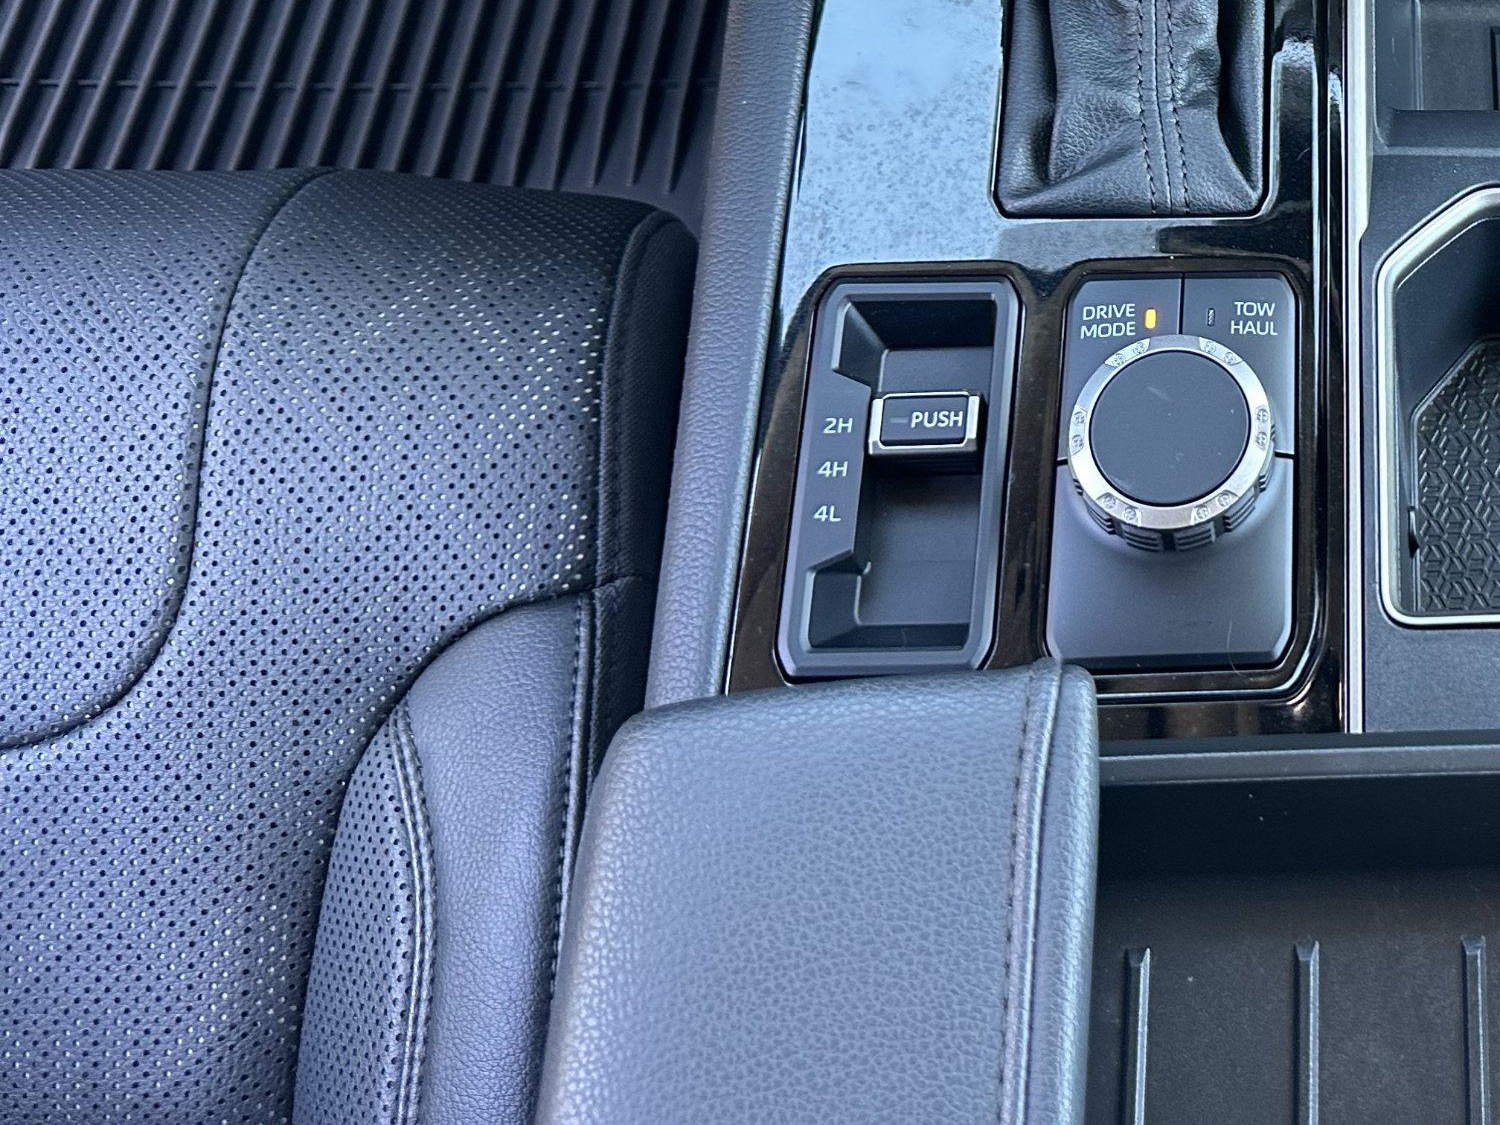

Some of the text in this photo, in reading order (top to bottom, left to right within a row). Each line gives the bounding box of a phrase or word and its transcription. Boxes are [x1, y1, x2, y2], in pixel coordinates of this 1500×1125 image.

[1082, 303, 1136, 321] DRIVE
[1234, 301, 1276, 317] TOW
[1080, 321, 1136, 339] MODE
[1230, 320, 1279, 336] HAUL
[822, 417, 854, 434] 2H
[910, 410, 964, 429] PUSH
[817, 461, 849, 478] 4H
[813, 505, 842, 523] 4L
